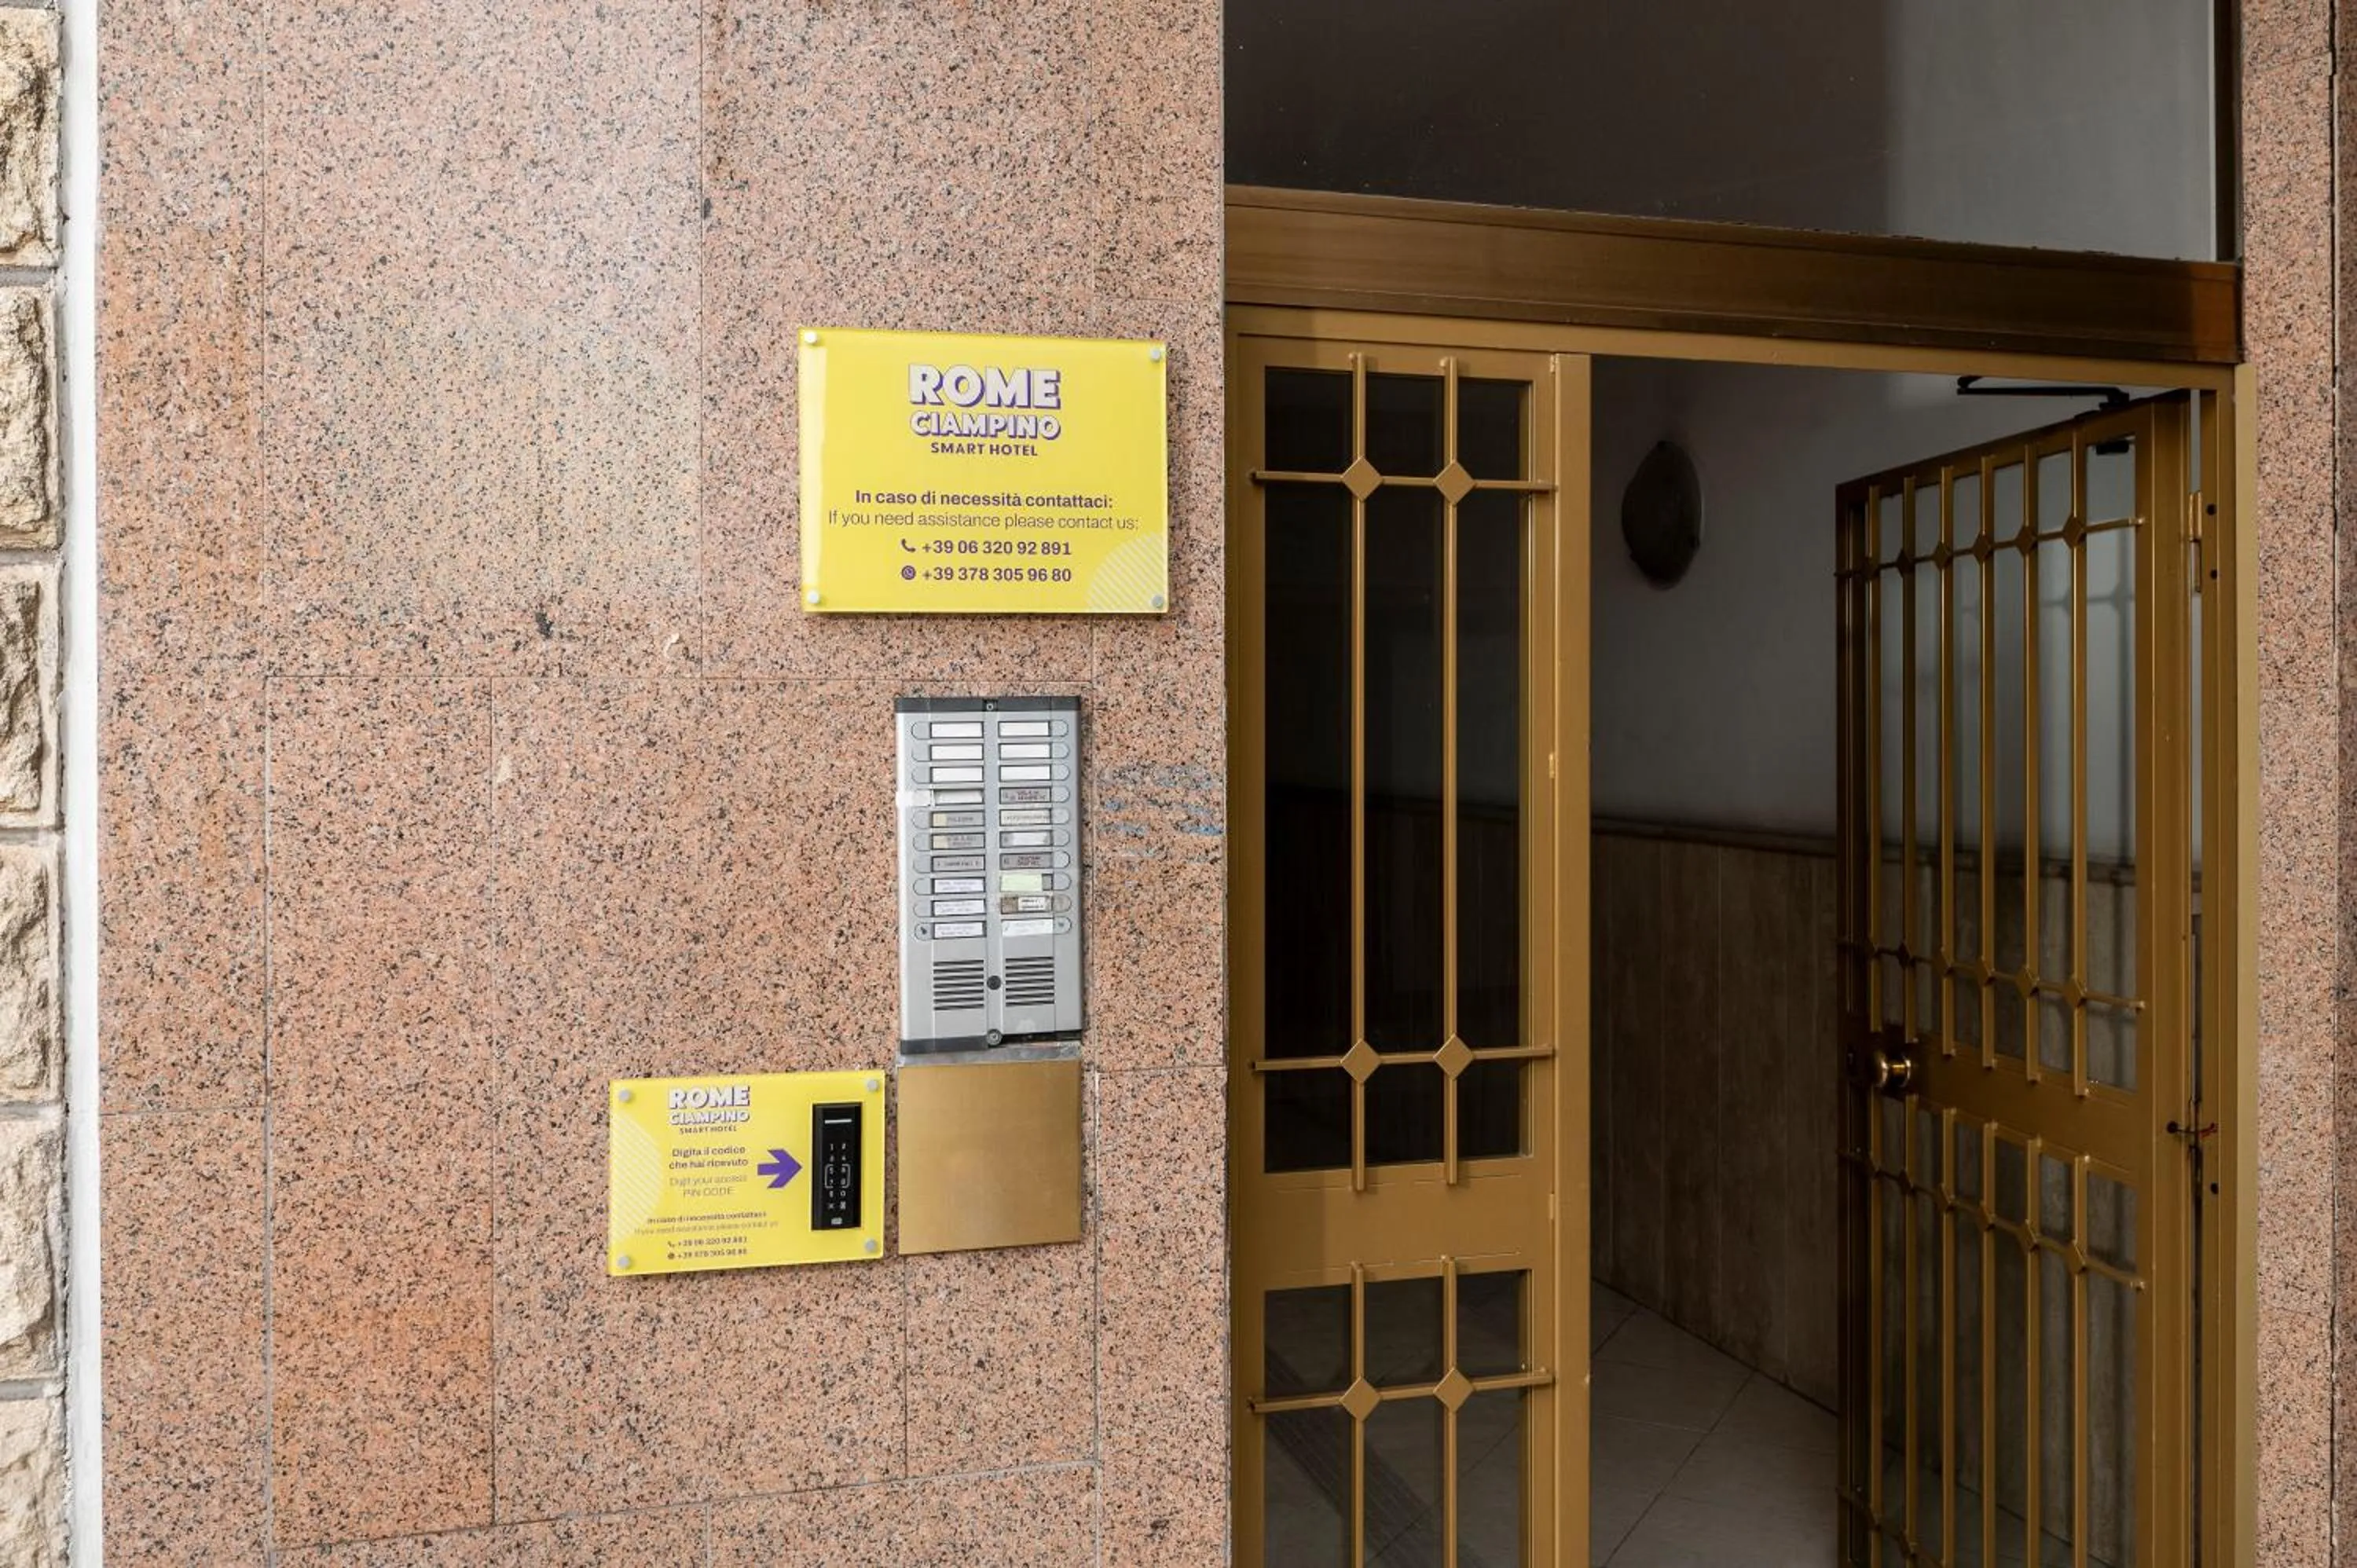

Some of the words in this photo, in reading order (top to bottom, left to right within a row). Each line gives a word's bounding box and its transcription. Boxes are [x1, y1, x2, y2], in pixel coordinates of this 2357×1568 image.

[909, 364, 1061, 409] ROME
[910, 410, 1061, 440] CIAMPINO
[931, 442, 985, 455] SMART
[989, 444, 1038, 456] HOTEL
[856, 490, 871, 504] In
[875, 493, 917, 504] caso
[921, 490, 936, 505] di
[940, 493, 1022, 507] necessità
[1025, 495, 1113, 508] contattaci:
[829, 511, 838, 525] If
[841, 514, 870, 527] you
[874, 512, 914, 526] need
[918, 512, 999, 527] assistance
[1005, 514, 1054, 530] please
[1058, 515, 1113, 529] contact
[922, 540, 953, 554] +39
[958, 540, 978, 554] 06
[983, 540, 1013, 554] 320
[1017, 541, 1037, 555] 92
[1041, 541, 1072, 555] 891
[922, 566, 954, 581] +39
[958, 566, 988, 581] 378
[993, 567, 1023, 581] 305
[1027, 568, 1047, 581] 96
[1052, 568, 1072, 581] 80
[669, 1086, 750, 1109] ROME
[669, 1109, 750, 1125] CIAMPINO
[672, 1148, 702, 1158] Digita
[669, 1160, 687, 1170] che
[703, 1186, 735, 1196] CODE
